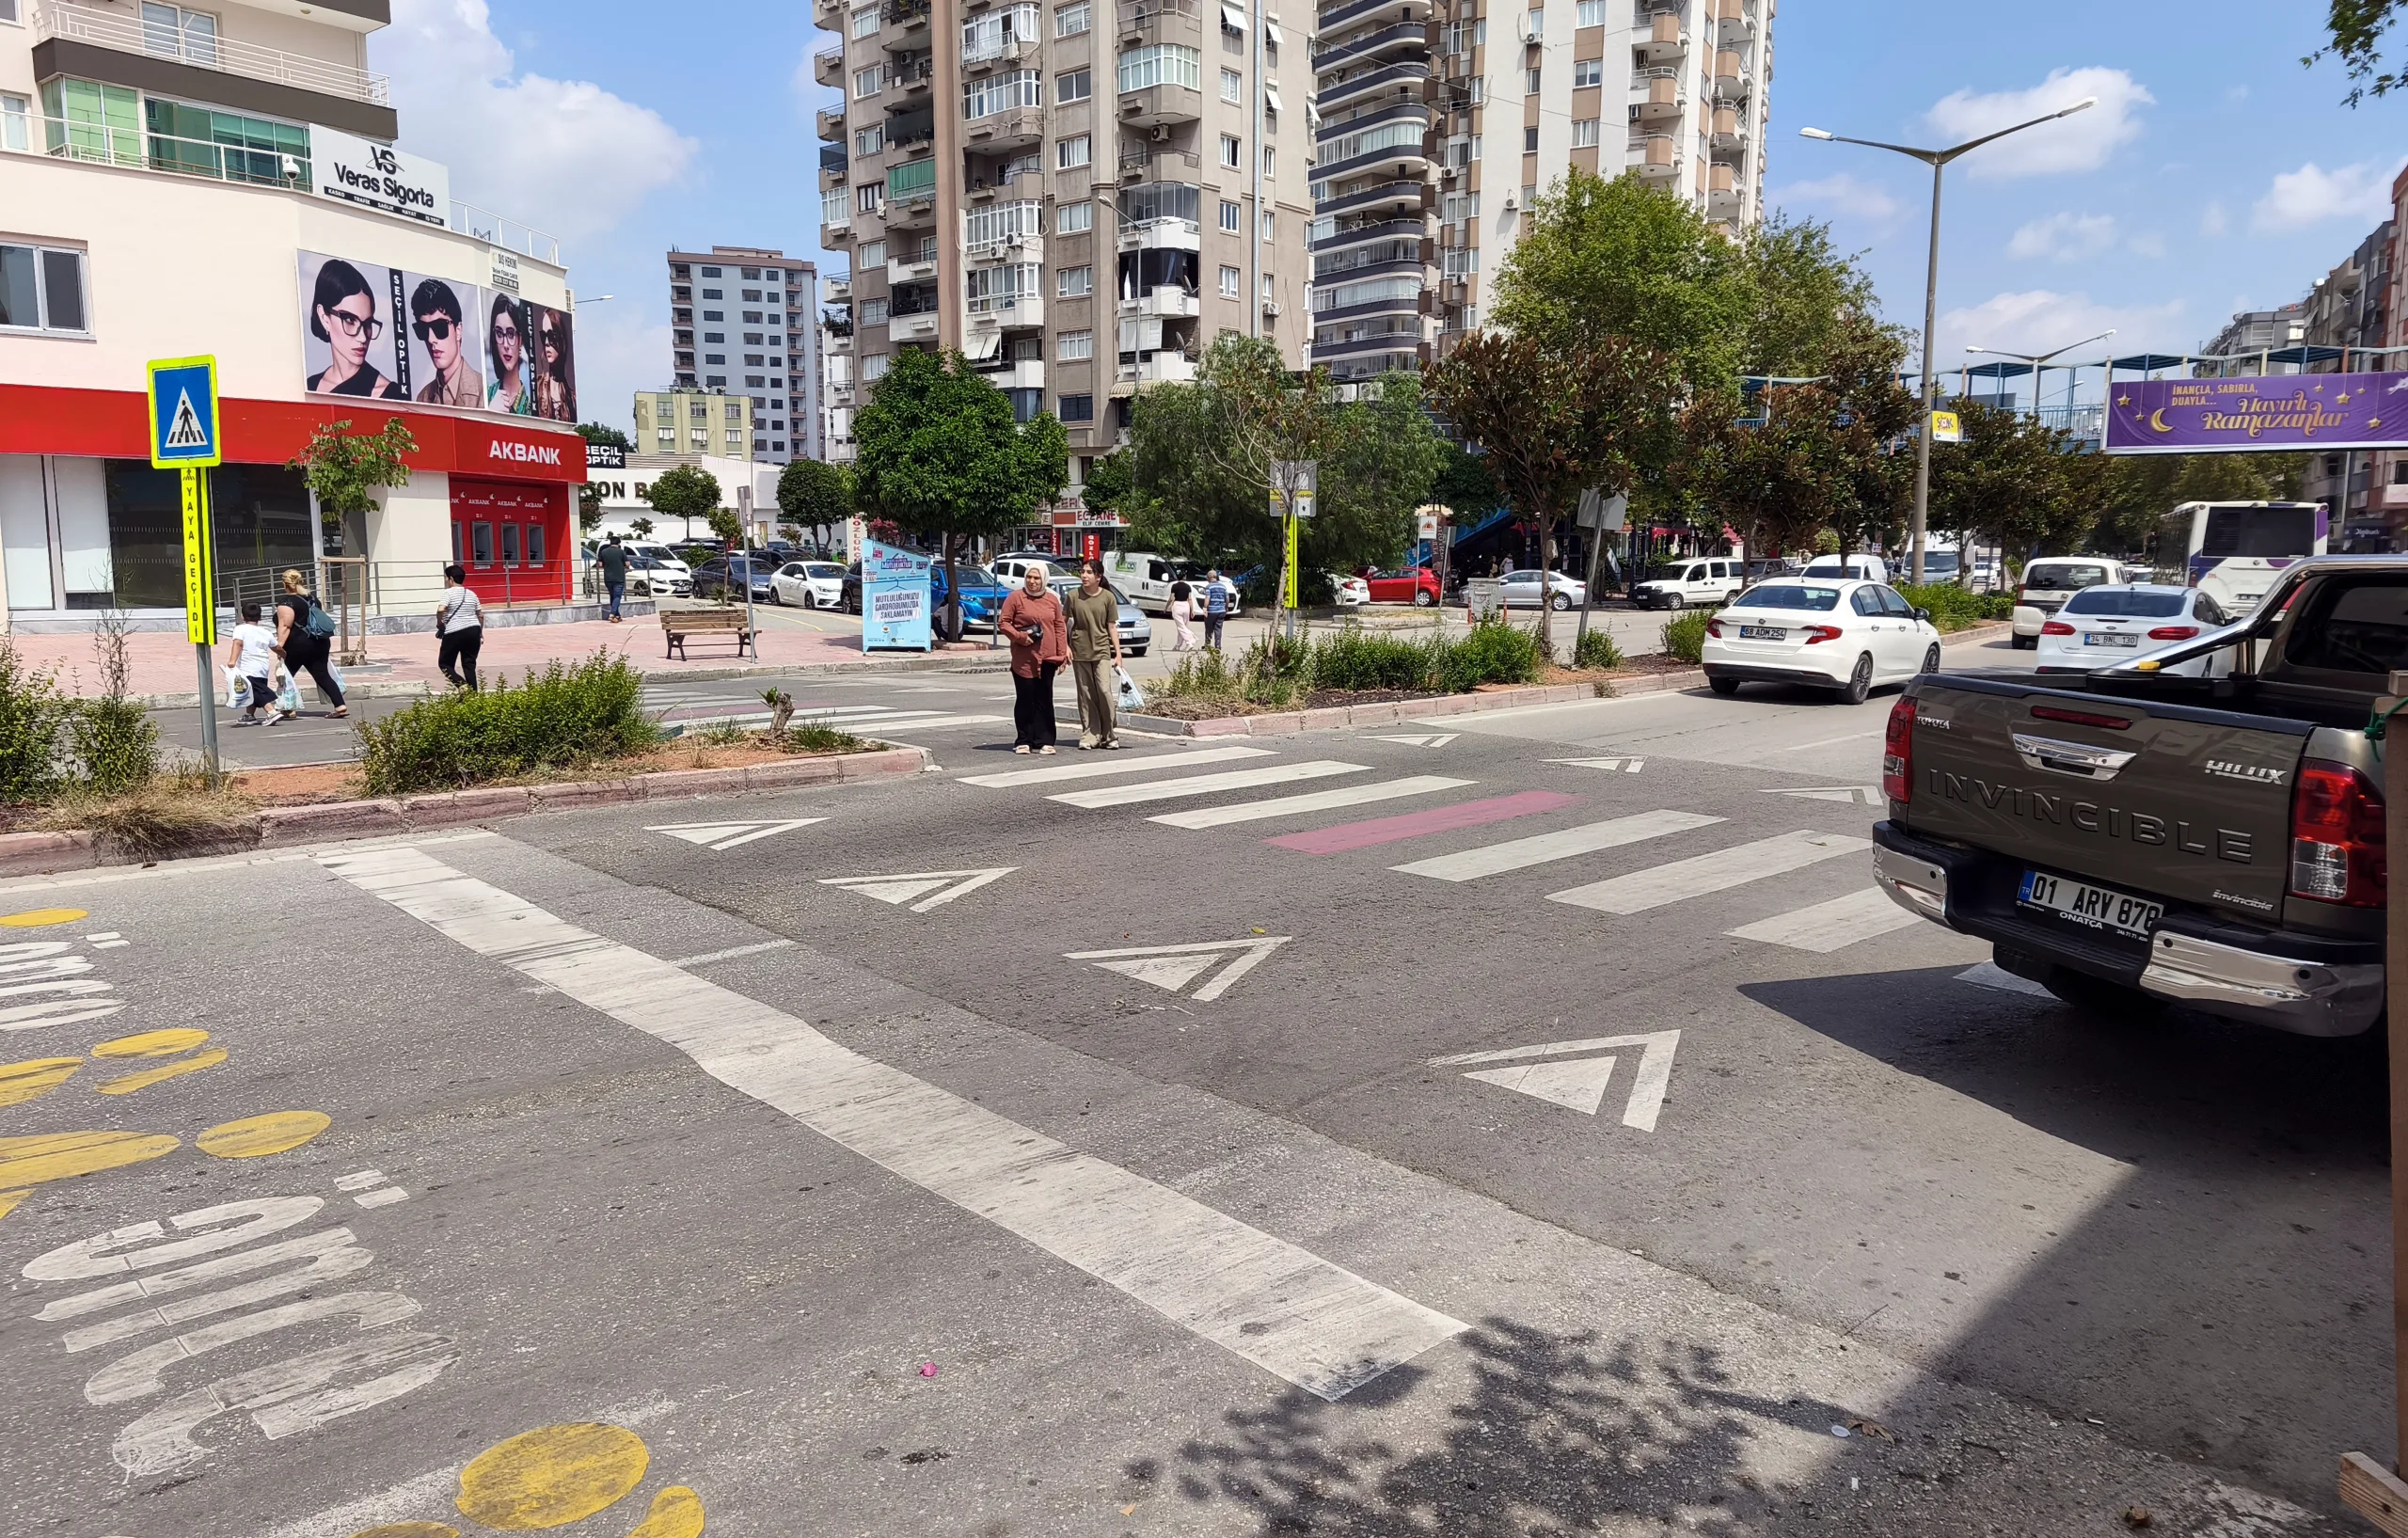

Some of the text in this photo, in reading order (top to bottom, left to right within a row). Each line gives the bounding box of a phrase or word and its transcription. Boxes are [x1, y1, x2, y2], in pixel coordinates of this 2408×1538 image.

[328, 189, 345, 198] KASKO
[354, 196, 371, 205] TRAFİK
[334, 162, 434, 208] Veras Sigorta
[393, 275, 408, 395] SEÇİL OPTİK
[2172, 383, 2258, 397] İNANÇLA, SABIRLA,
[2238, 389, 2307, 414] Hayırlı
[2201, 401, 2350, 437] Ramazanlar
[489, 440, 562, 466] AKBANK
[596, 481, 626, 498] ON
[186, 486, 198, 638] YAYA GEÇİDİ
[1917, 716, 1950, 730] TOYOTA
[2205, 760, 2287, 785] HILUX
[1929, 769, 2252, 864] INVINCIBLE
[2032, 876, 2058, 905] 01
[2072, 886, 2115, 919] ARV
[2059, 912, 2103, 929] ONATÇA
